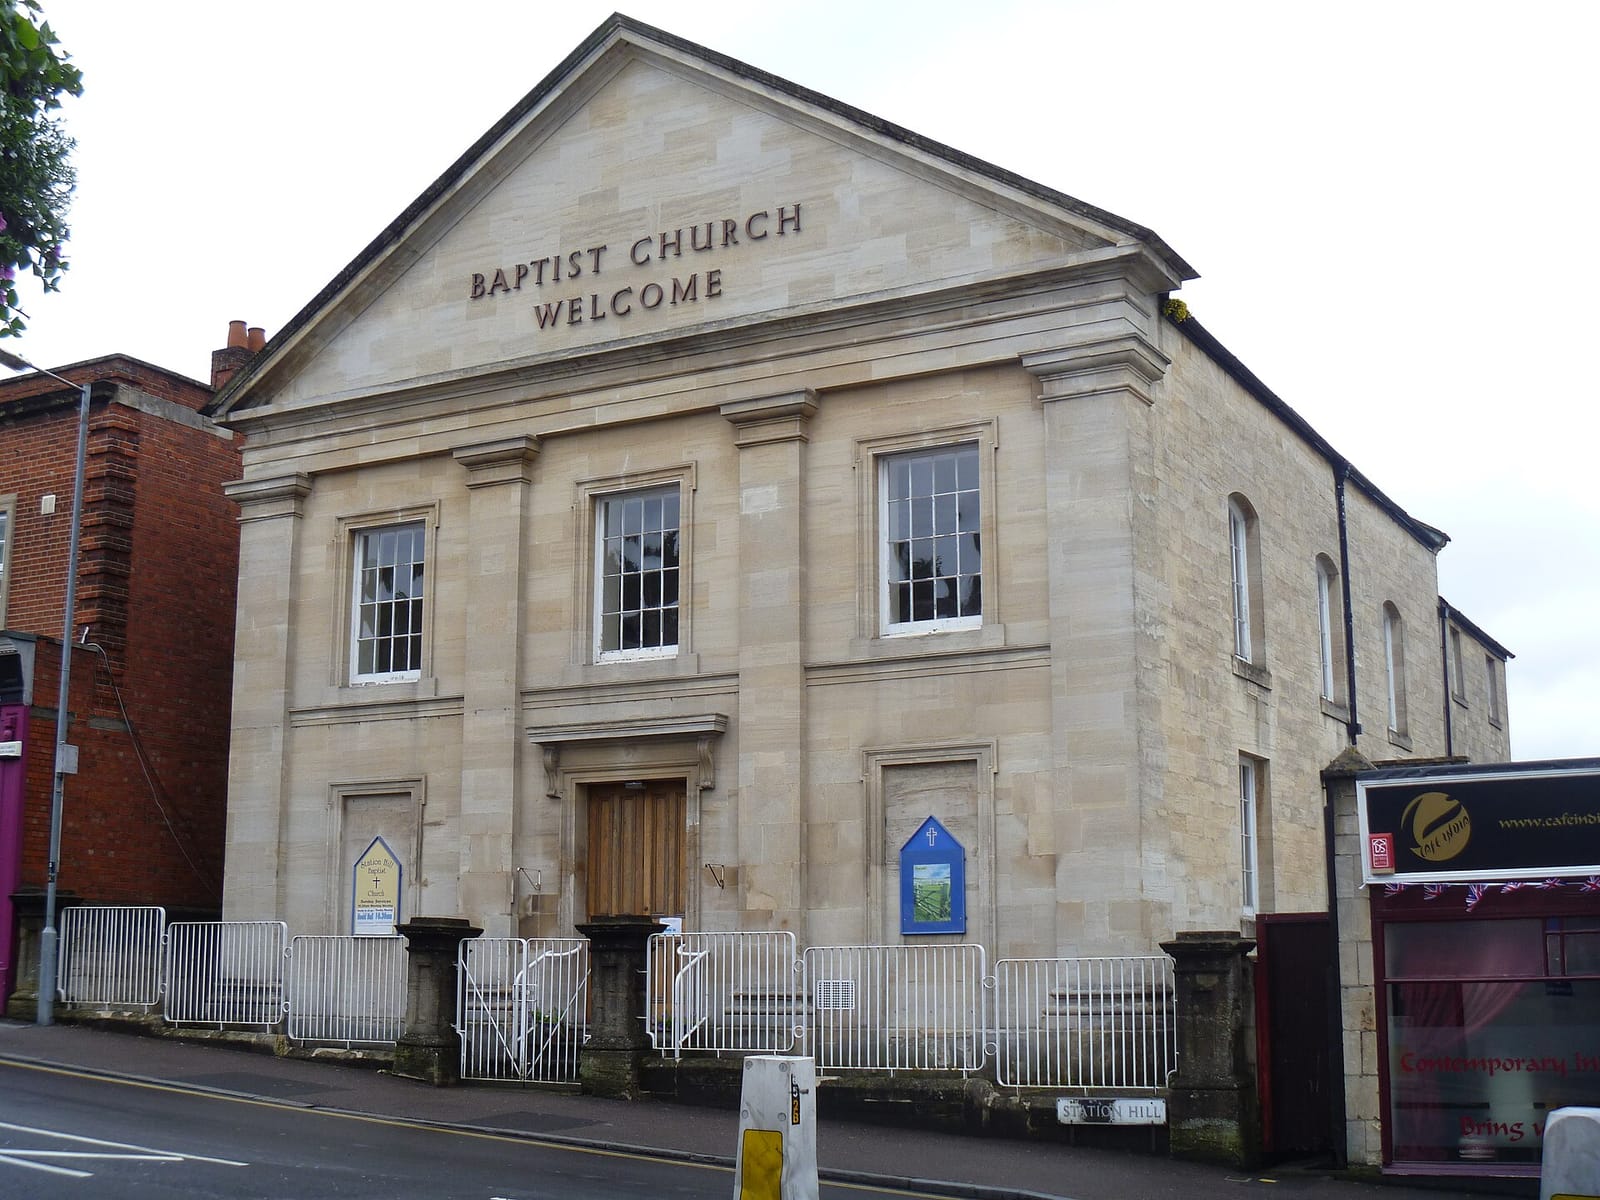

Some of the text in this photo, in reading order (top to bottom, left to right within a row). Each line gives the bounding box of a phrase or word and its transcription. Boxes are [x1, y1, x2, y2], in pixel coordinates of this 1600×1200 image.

[470, 203, 802, 299] BAPTIST CHURCH
[533, 268, 723, 330] WELCOME
[1401, 1052, 1568, 1077] Contemporary
[1063, 1104, 1161, 1118] STATION HILL
[1459, 1117, 1524, 1142] Bring
